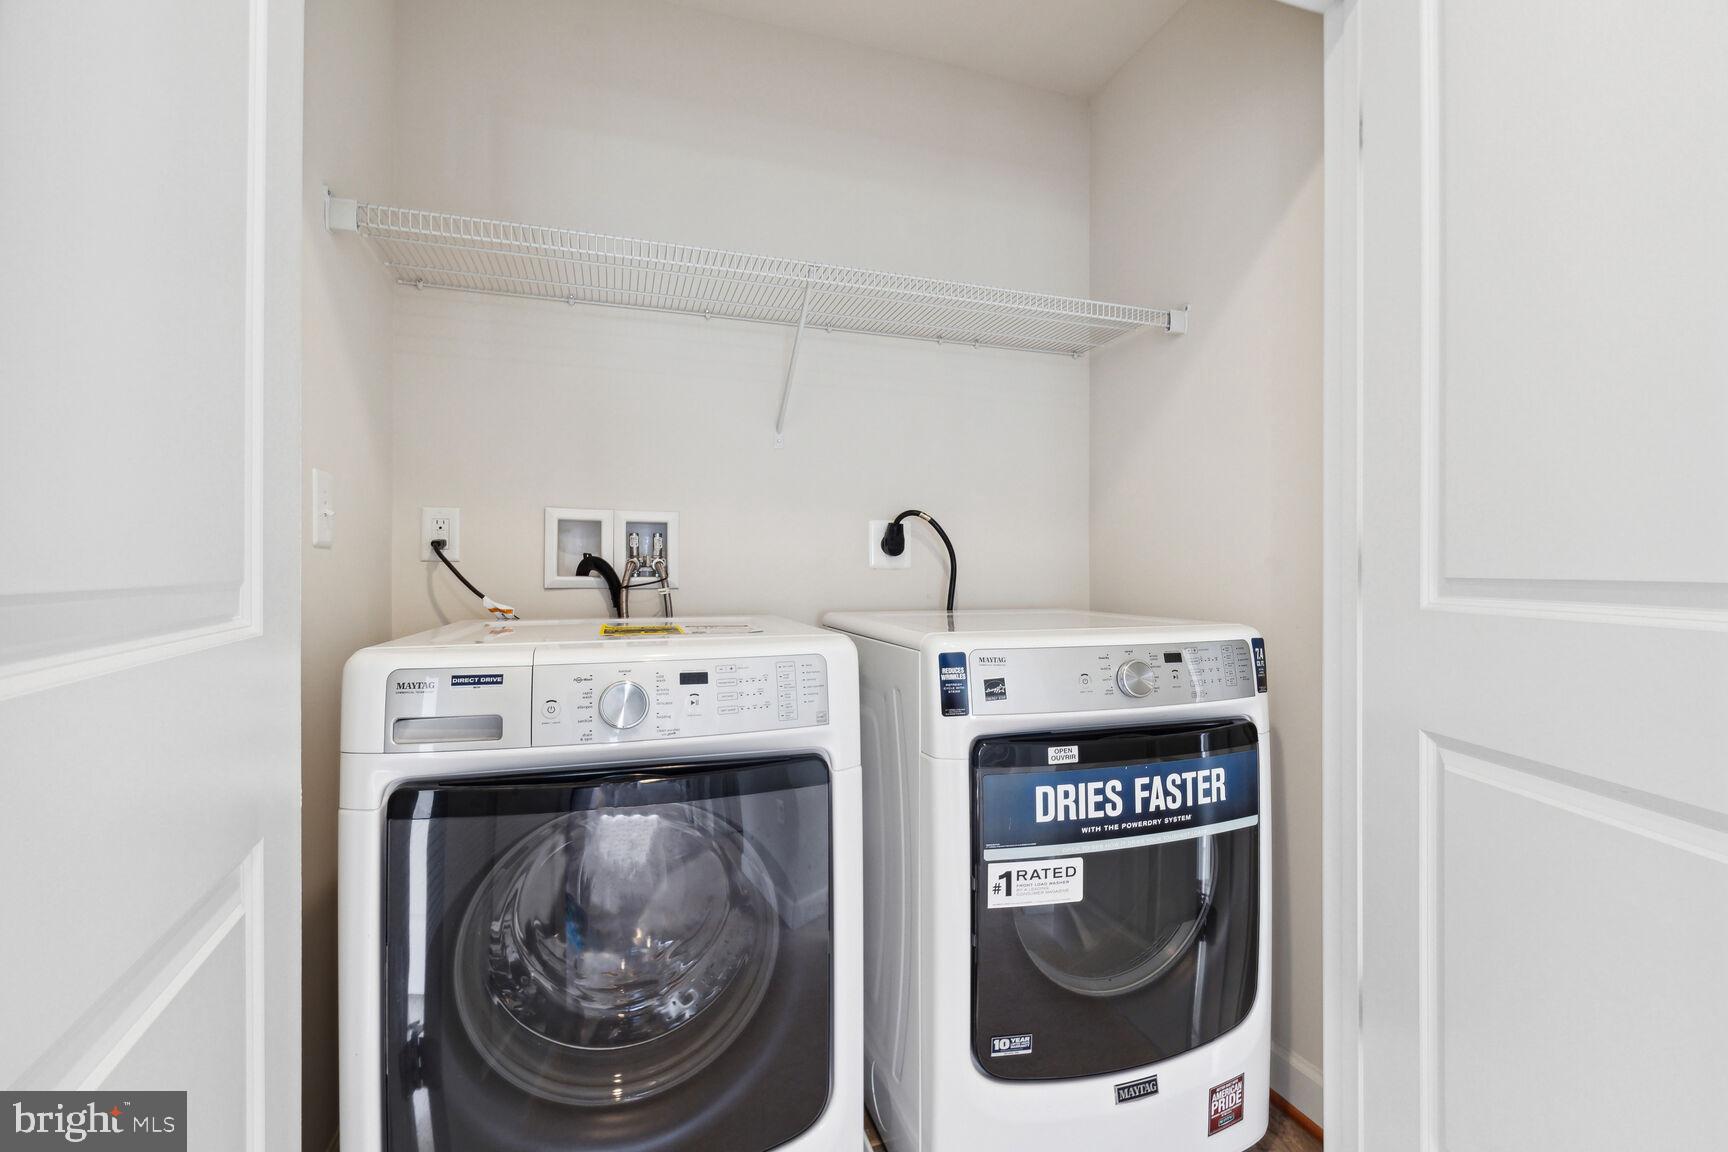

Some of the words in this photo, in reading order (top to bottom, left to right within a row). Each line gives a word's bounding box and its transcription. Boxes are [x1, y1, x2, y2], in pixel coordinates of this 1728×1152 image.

[979, 656, 1007, 664] MAYTAG
[396, 681, 435, 690] MAYTAG
[1050, 753, 1077, 762] OUVRIR
[1054, 747, 1073, 755] OPEN
[1035, 779, 1123, 823] DRIES
[1134, 767, 1227, 814] FASTER
[1081, 826, 1101, 834] WITH
[1104, 824, 1119, 832] THE
[1121, 819, 1162, 830] POWERDRY
[1164, 815, 1191, 825] SYSTEM
[992, 870, 1012, 897] #1
[1016, 866, 1077, 881] RATED
[993, 1038, 1010, 1050] 10
[1119, 1081, 1157, 1100] MAYTAG
[1211, 1081, 1243, 1102] AMERICAN
[1211, 1092, 1241, 1115] PRIDE
